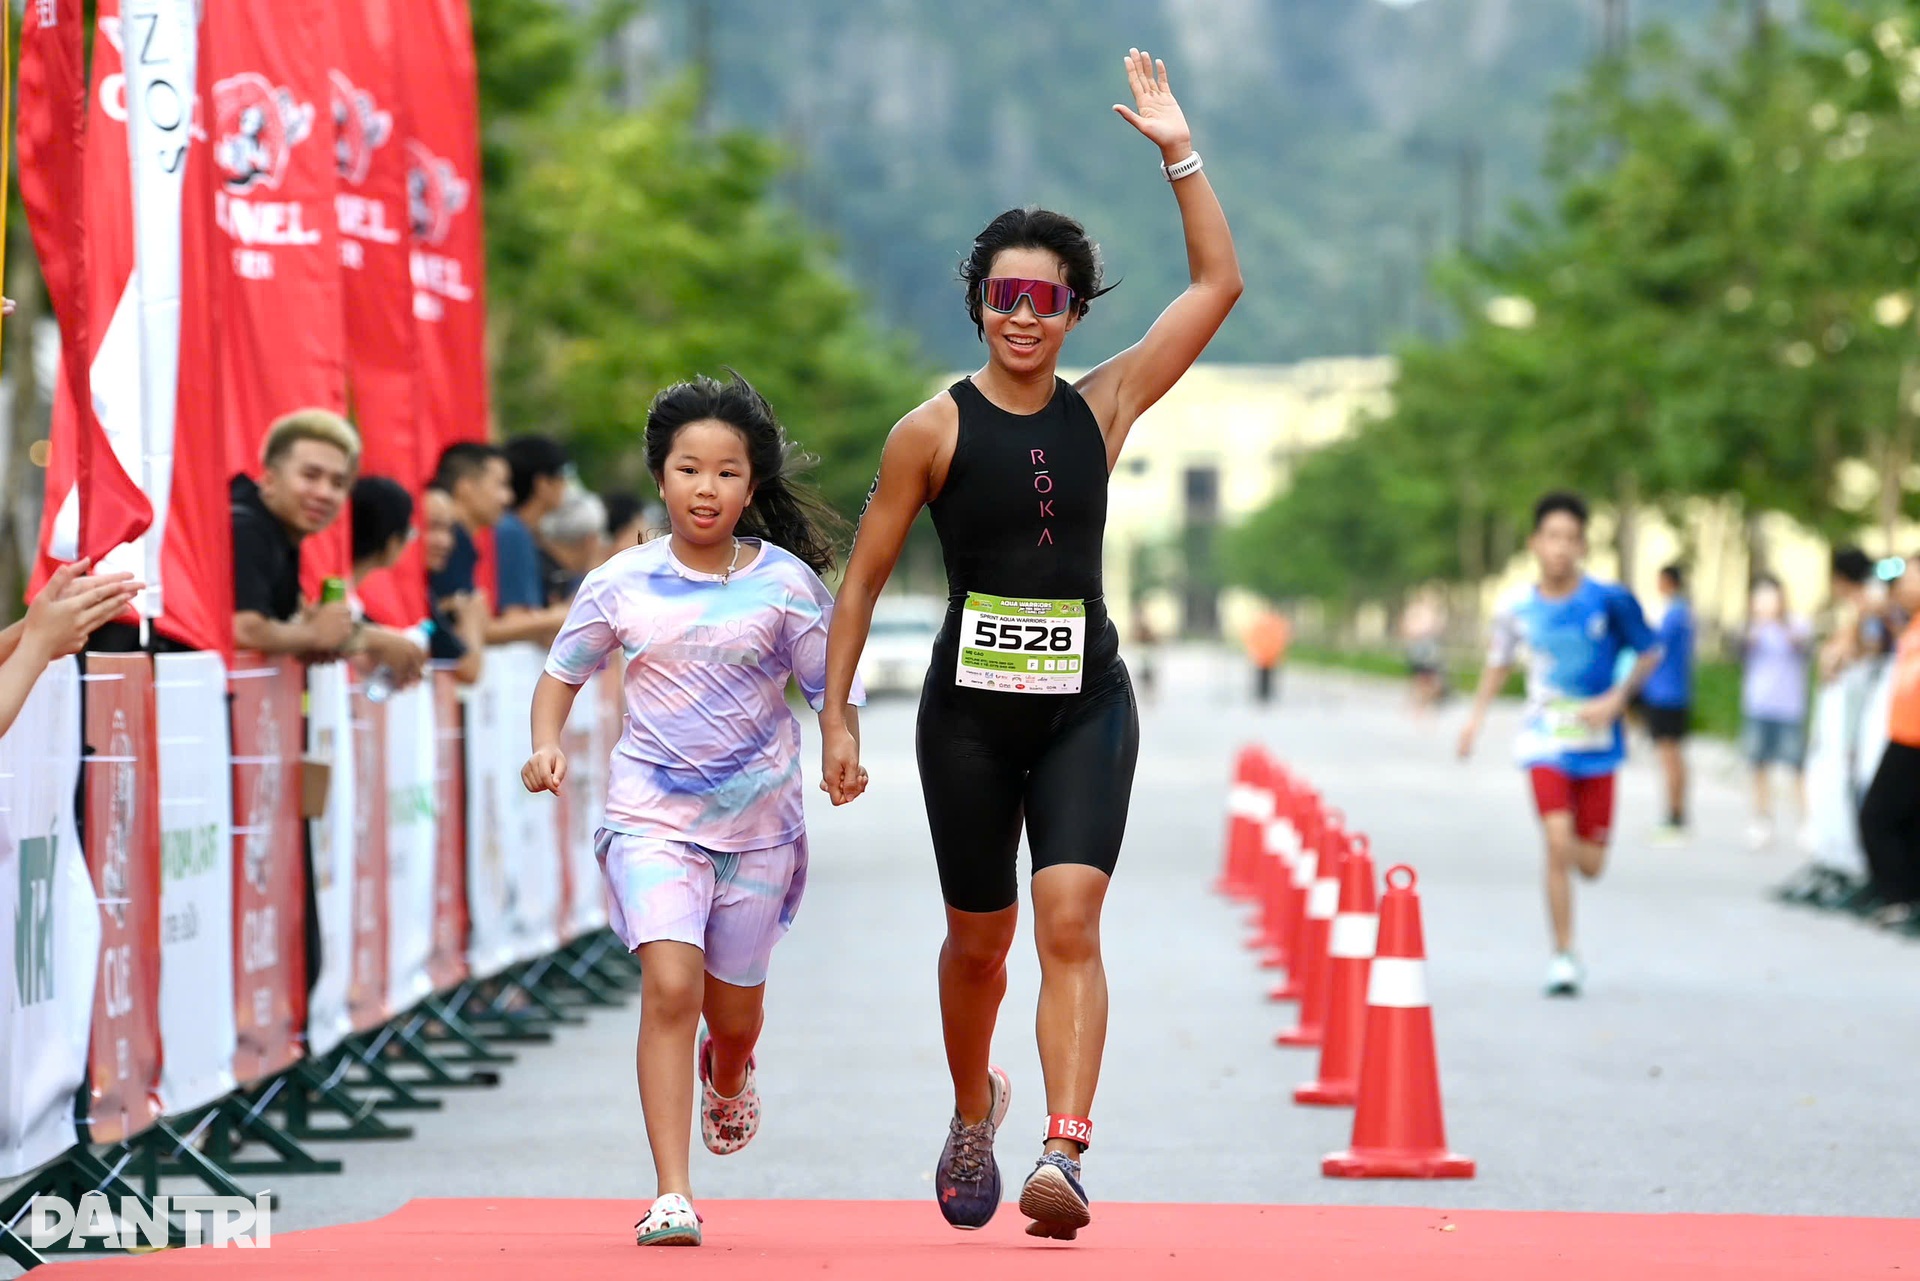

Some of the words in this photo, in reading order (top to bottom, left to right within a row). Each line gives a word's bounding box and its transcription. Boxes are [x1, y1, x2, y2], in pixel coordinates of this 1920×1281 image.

[980, 613, 999, 621] SPRINT
[999, 615, 1016, 623] AQUA
[974, 620, 1072, 652] 5528
